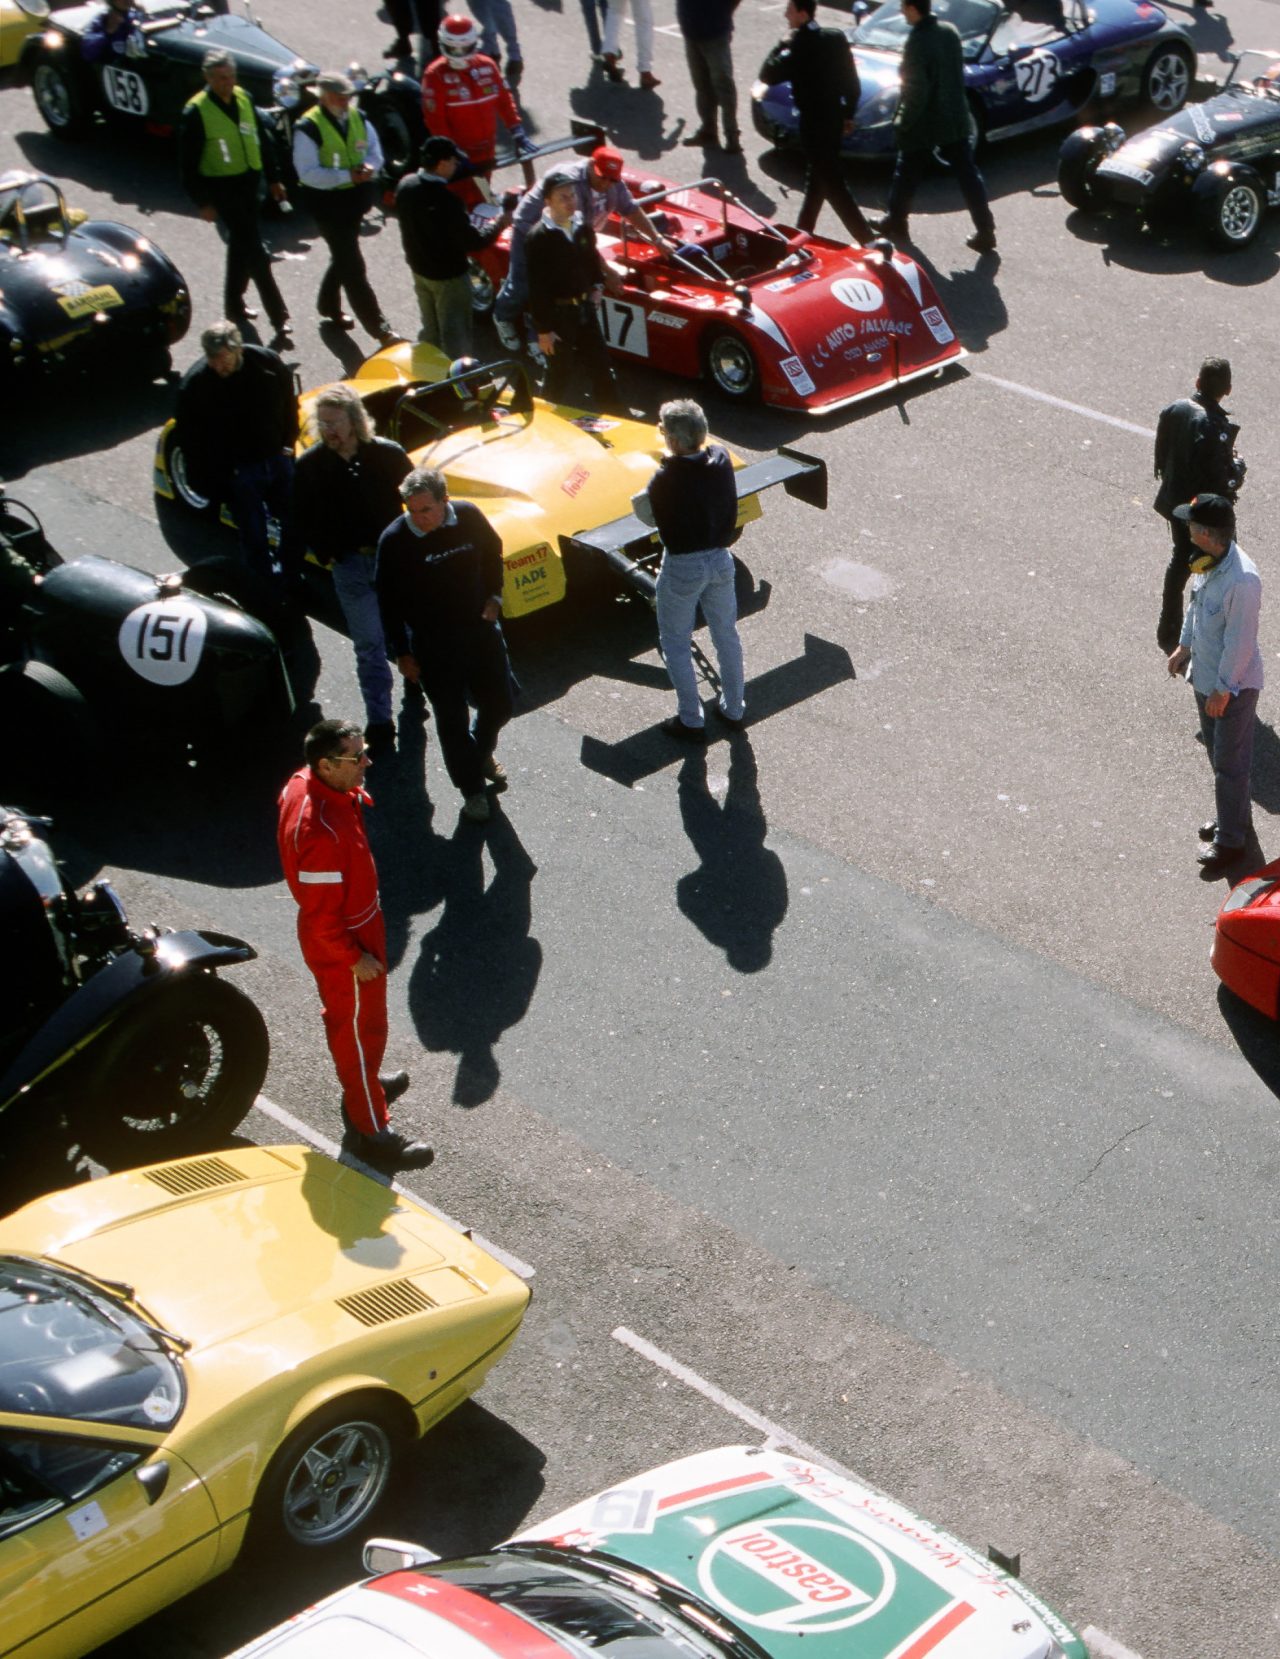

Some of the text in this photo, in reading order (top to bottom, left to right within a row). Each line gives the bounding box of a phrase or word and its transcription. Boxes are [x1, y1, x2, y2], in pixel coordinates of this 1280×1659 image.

[1018, 53, 1059, 98] 273
[825, 322, 857, 352] AUTO
[860, 317, 914, 337] SALVAGE
[504, 552, 537, 571] Team
[136, 612, 194, 664] 151
[725, 1532, 853, 1603] Castrol
